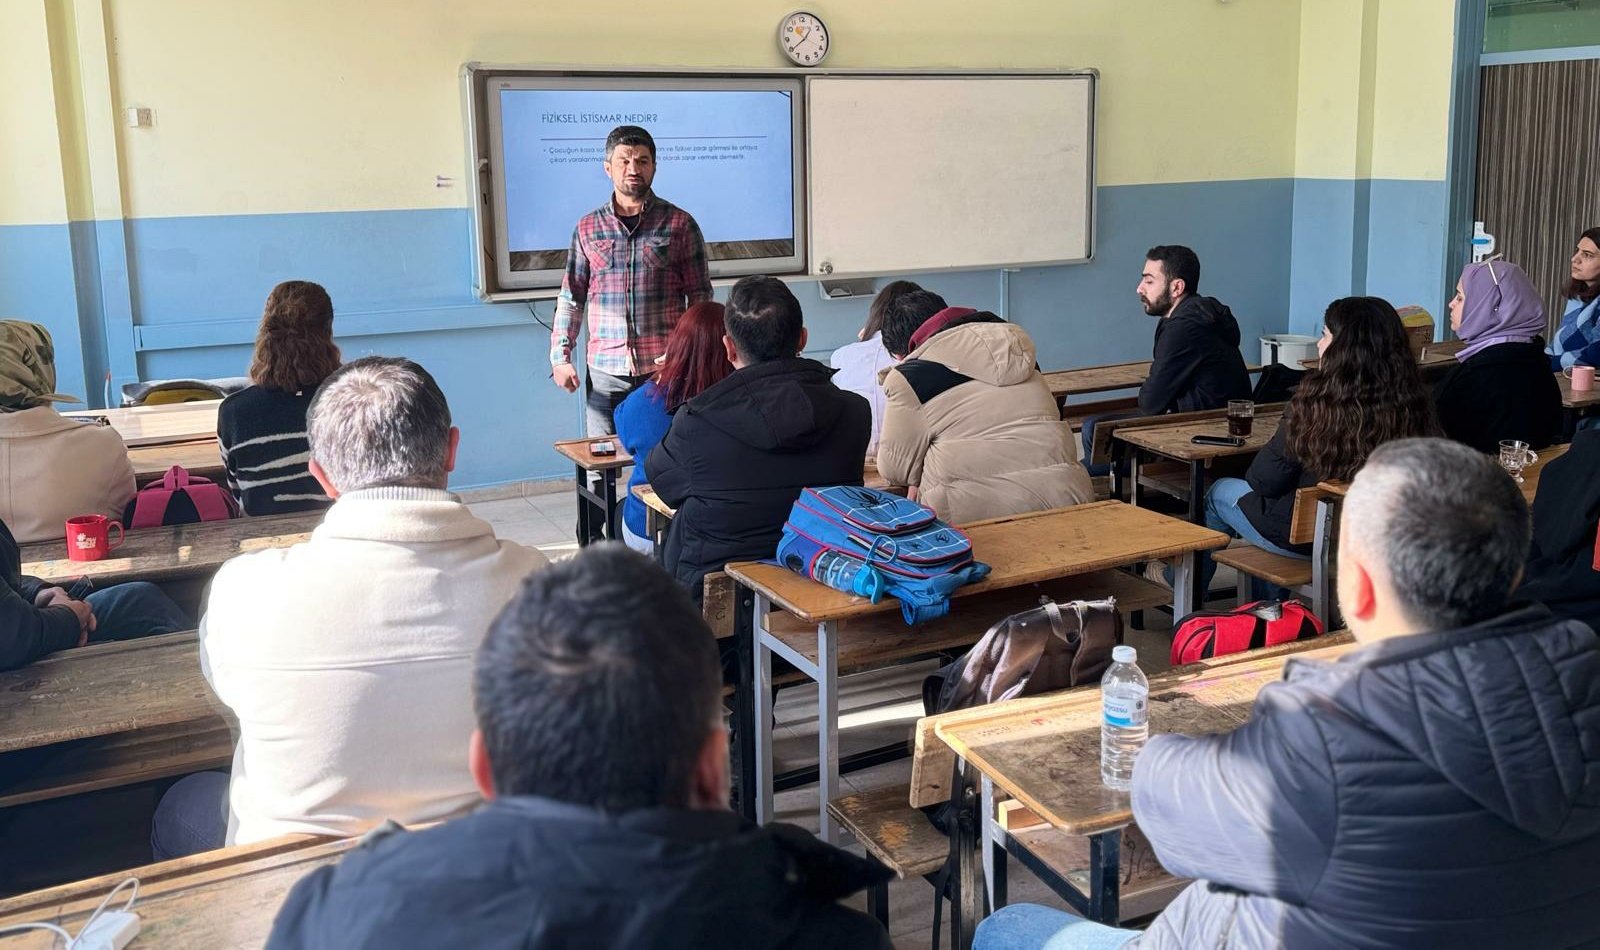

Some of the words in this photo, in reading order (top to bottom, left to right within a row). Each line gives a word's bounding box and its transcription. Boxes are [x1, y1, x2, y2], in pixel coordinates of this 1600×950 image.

[541, 112, 578, 123] FİZİKSEL
[580, 112, 622, 123] İSTİSMAR
[624, 113, 657, 123] NEDİR?
